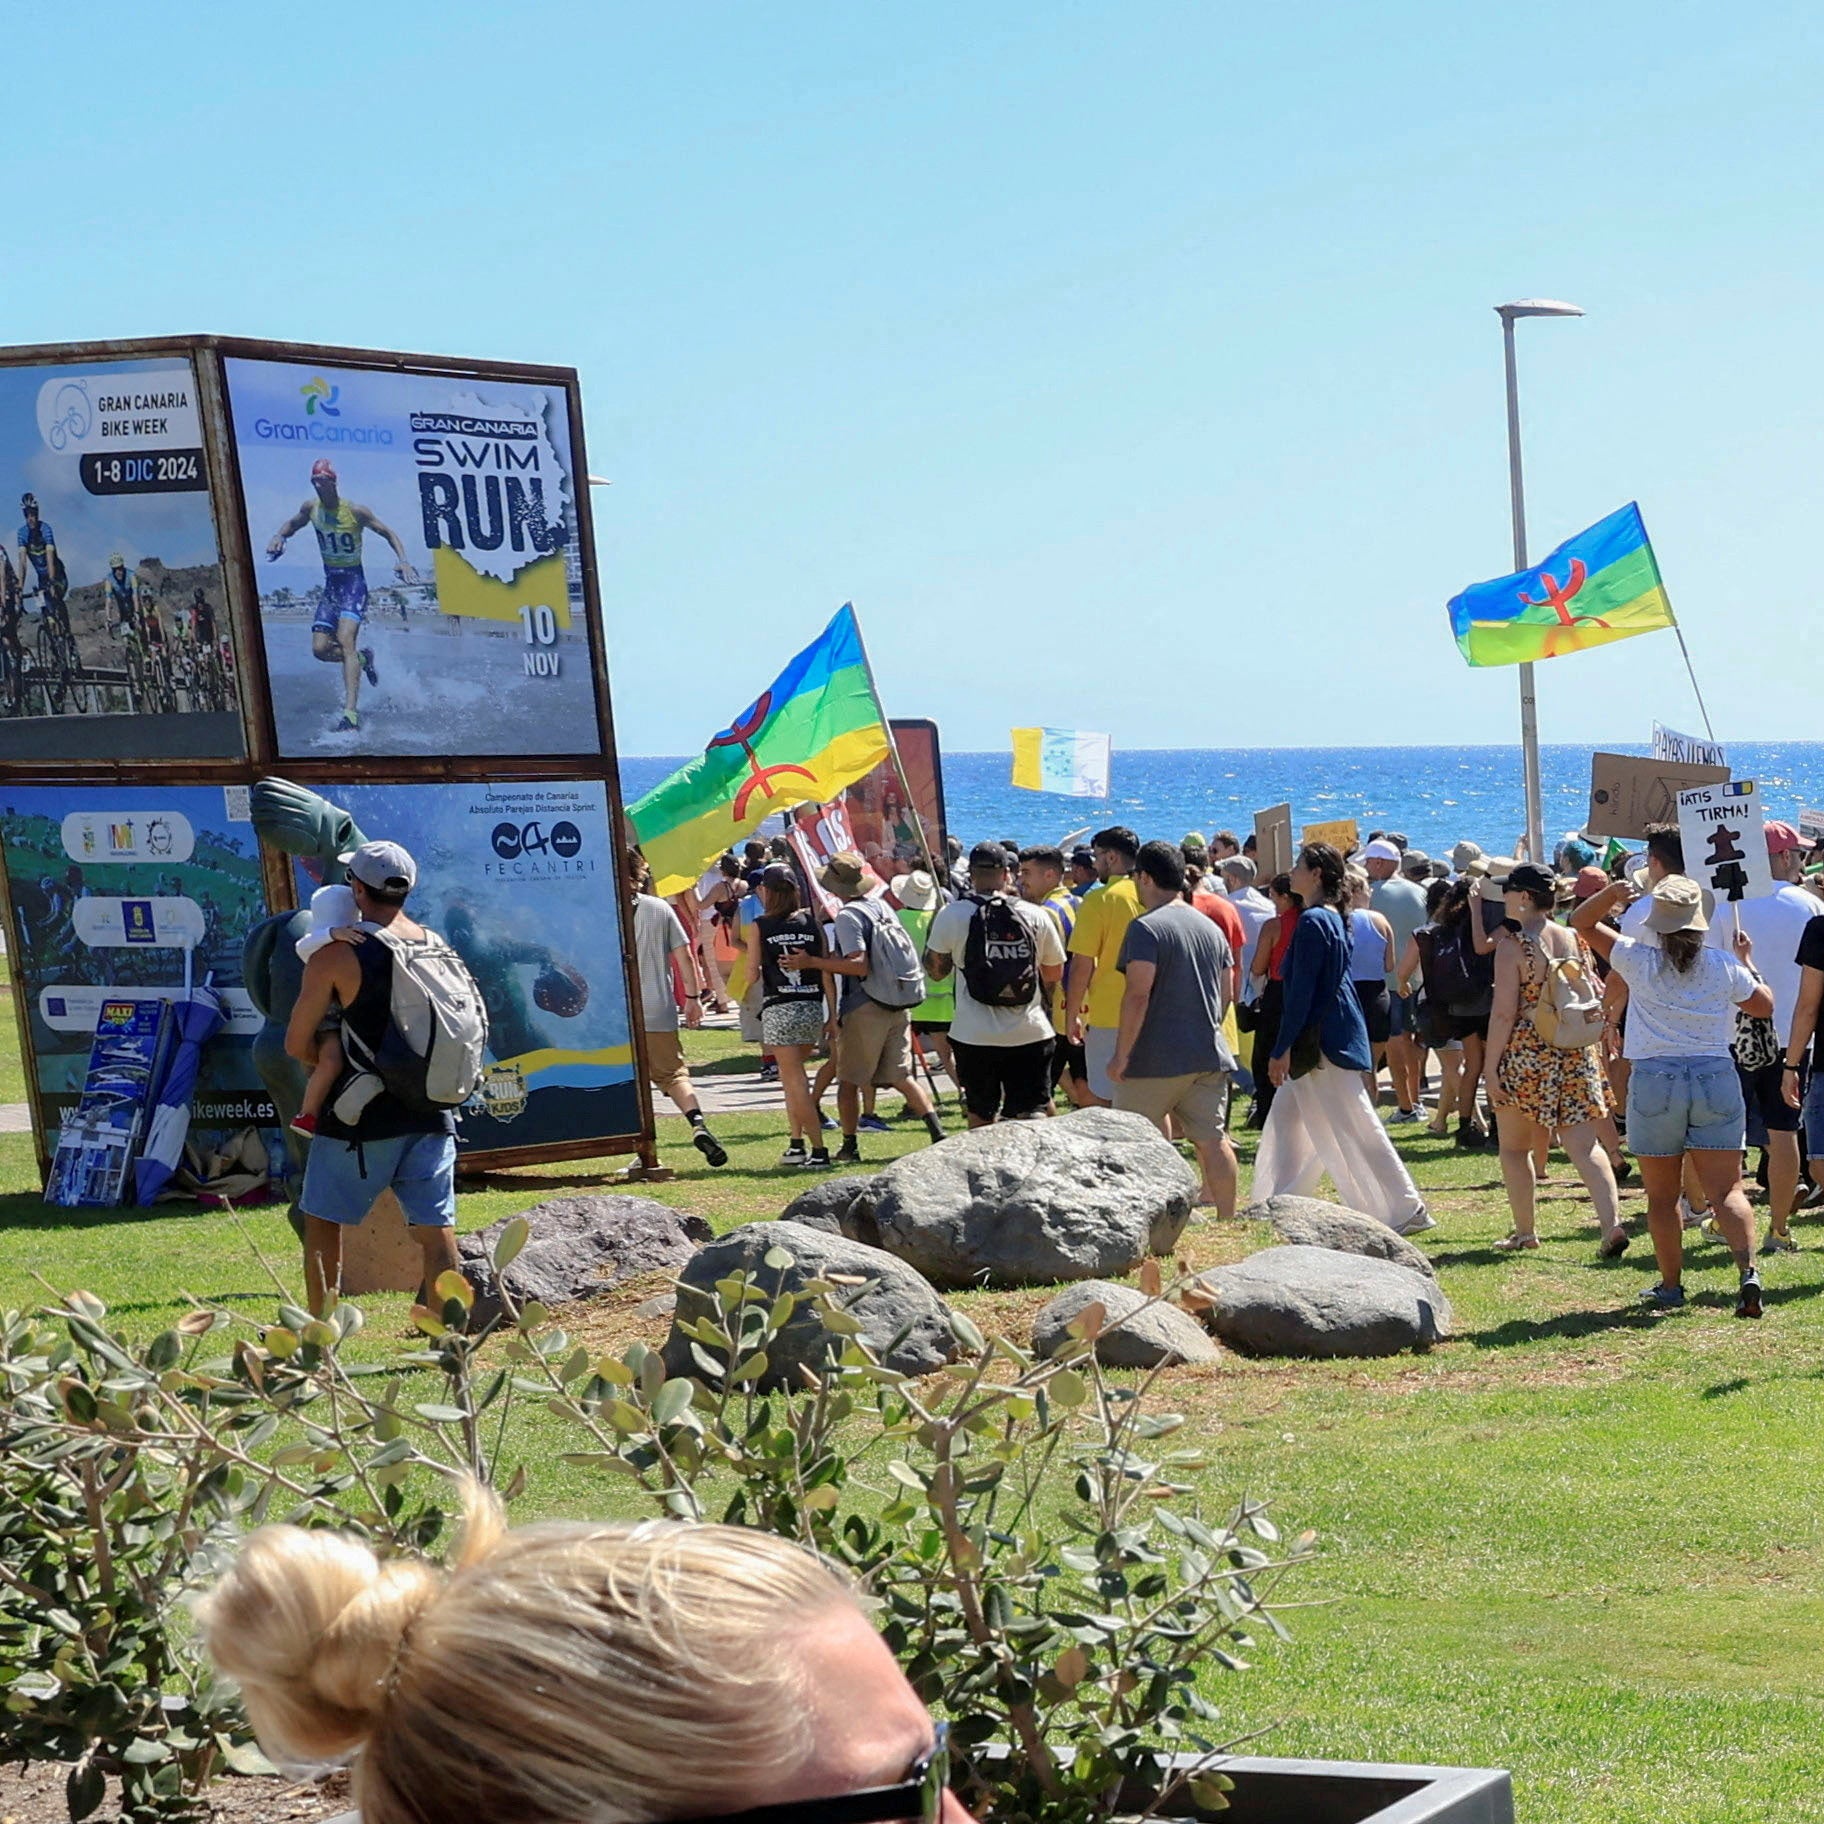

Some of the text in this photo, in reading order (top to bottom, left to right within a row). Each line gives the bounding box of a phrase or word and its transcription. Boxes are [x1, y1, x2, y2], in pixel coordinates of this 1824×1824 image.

[98, 392, 188, 412] GRAN CANARIA
[101, 418, 168, 437] BIKE WEEK
[255, 418, 393, 445] GranCanaria
[413, 438, 539, 471] SWIM
[94, 456, 197, 483] 1-8 DIC 2024
[418, 472, 557, 551] RUN
[518, 604, 556, 645] 10
[523, 653, 559, 677] NOV
[485, 791, 579, 803] Campeonato de Canarias
[469, 805, 504, 814] Absoluto
[505, 804, 534, 815] Parejas
[535, 804, 570, 813] Distancia
[1695, 803, 1749, 822] TIRMA!
[485, 860, 595, 875] FECANTRI
[766, 933, 796, 945] TURBO
[986, 940, 1031, 959] ANS
[106, 1007, 133, 1017] MAXI
[489, 1081, 519, 1100] RUN
[192, 1100, 274, 1119] ikeweek.es
[491, 1101, 519, 1114] KIDS
